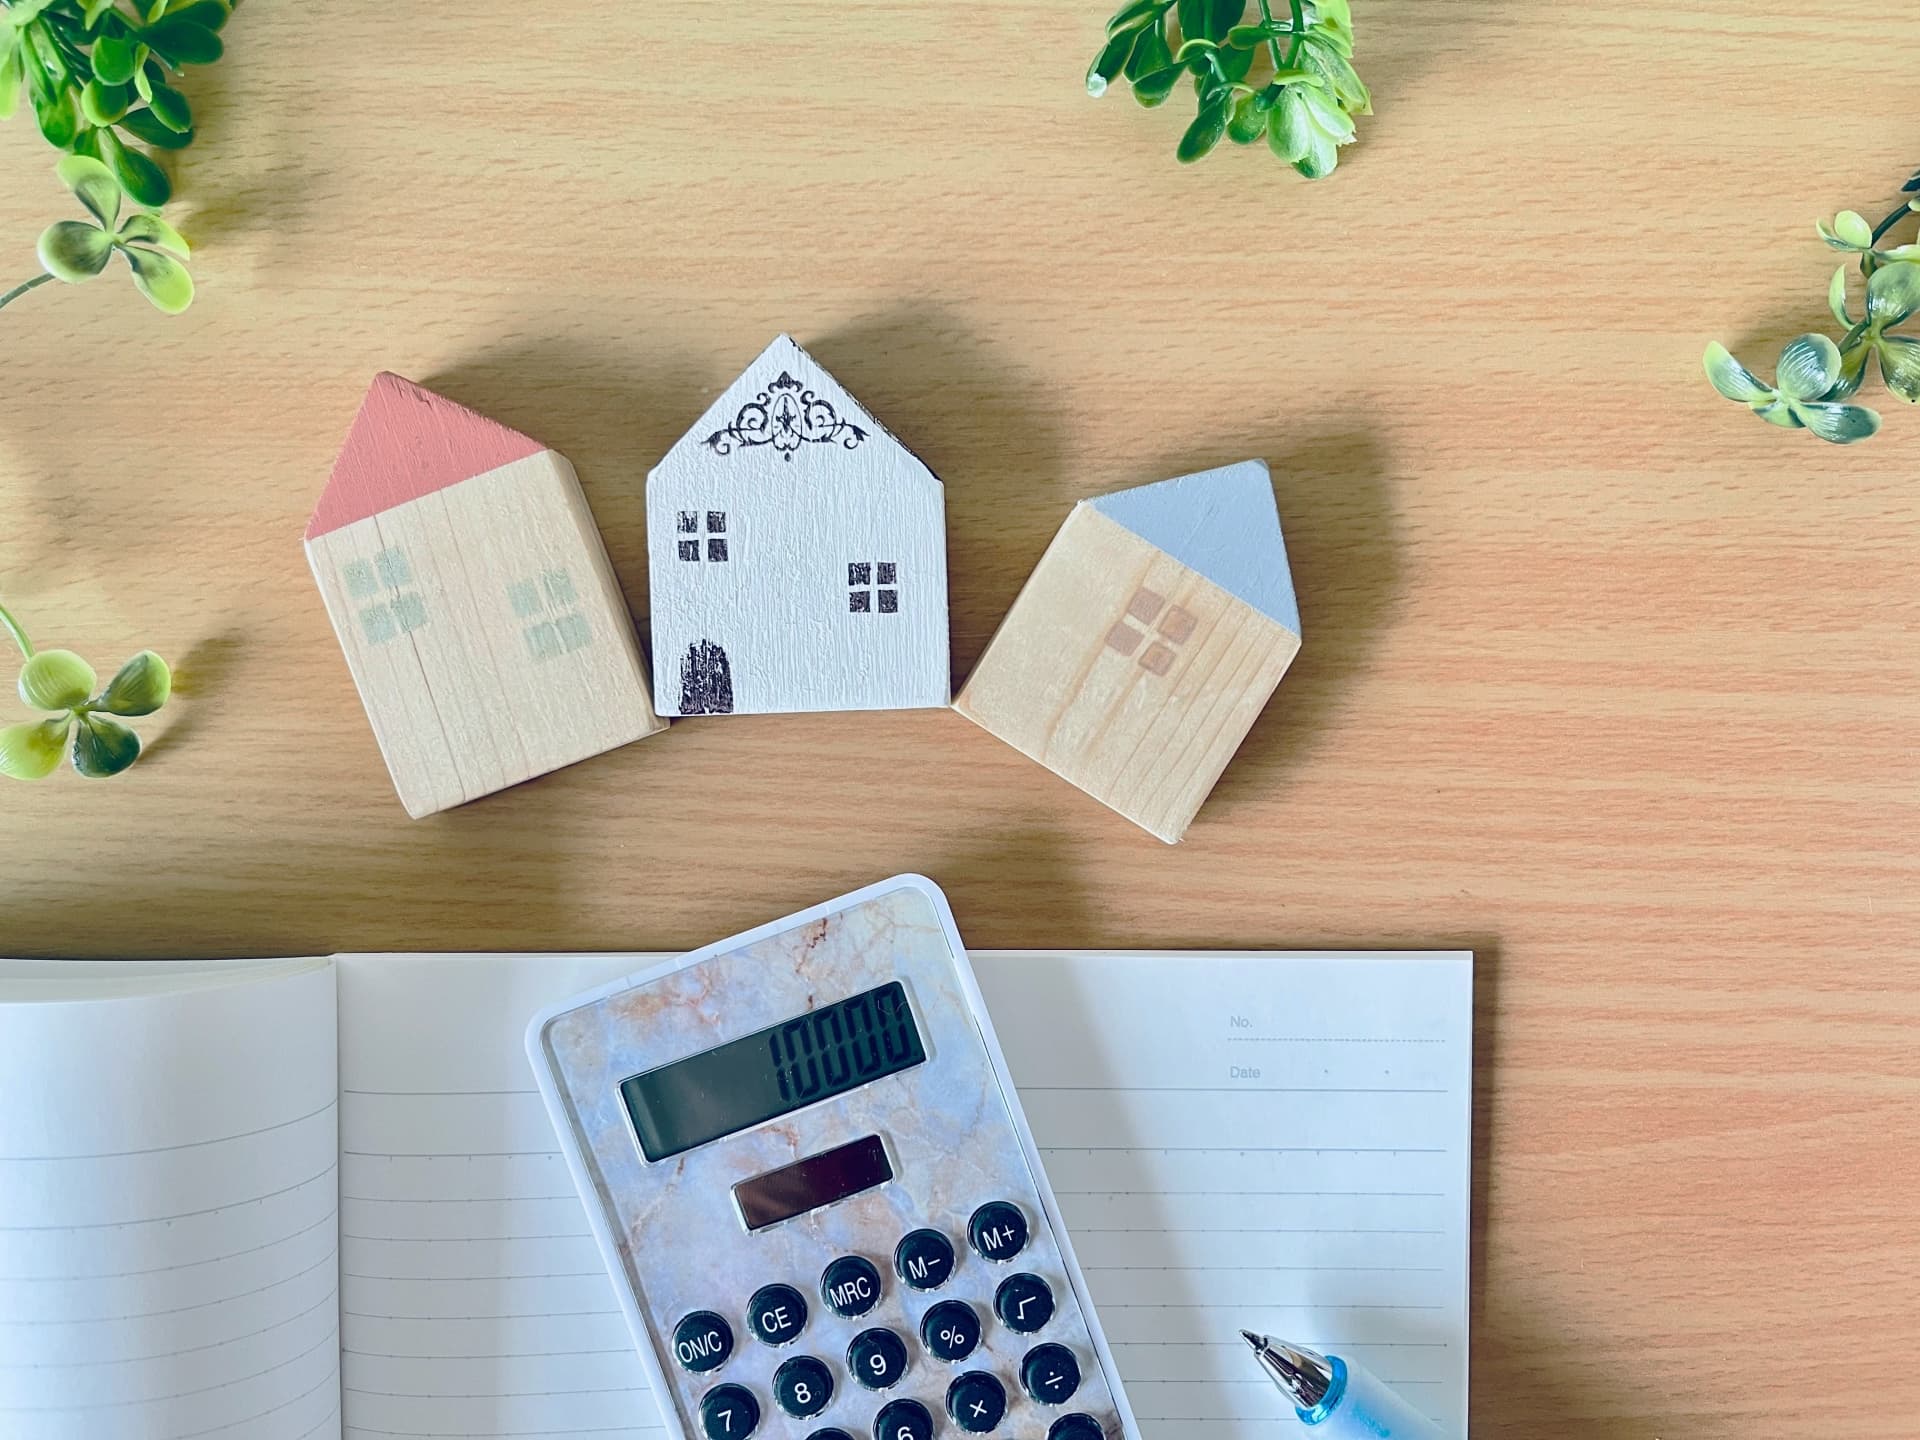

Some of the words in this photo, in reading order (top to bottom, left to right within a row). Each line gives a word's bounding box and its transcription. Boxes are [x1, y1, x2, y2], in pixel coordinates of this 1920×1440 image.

[1230, 1016, 1253, 1028] No.
[1230, 1066, 1261, 1079] Date
[982, 1224, 1015, 1252] M+
[830, 1277, 871, 1308] MRC
[762, 1306, 789, 1333] CE
[678, 1331, 722, 1364] ON/C
[869, 1354, 887, 1376] 9
[794, 1382, 812, 1404] 8
[717, 1409, 732, 1432] 7
